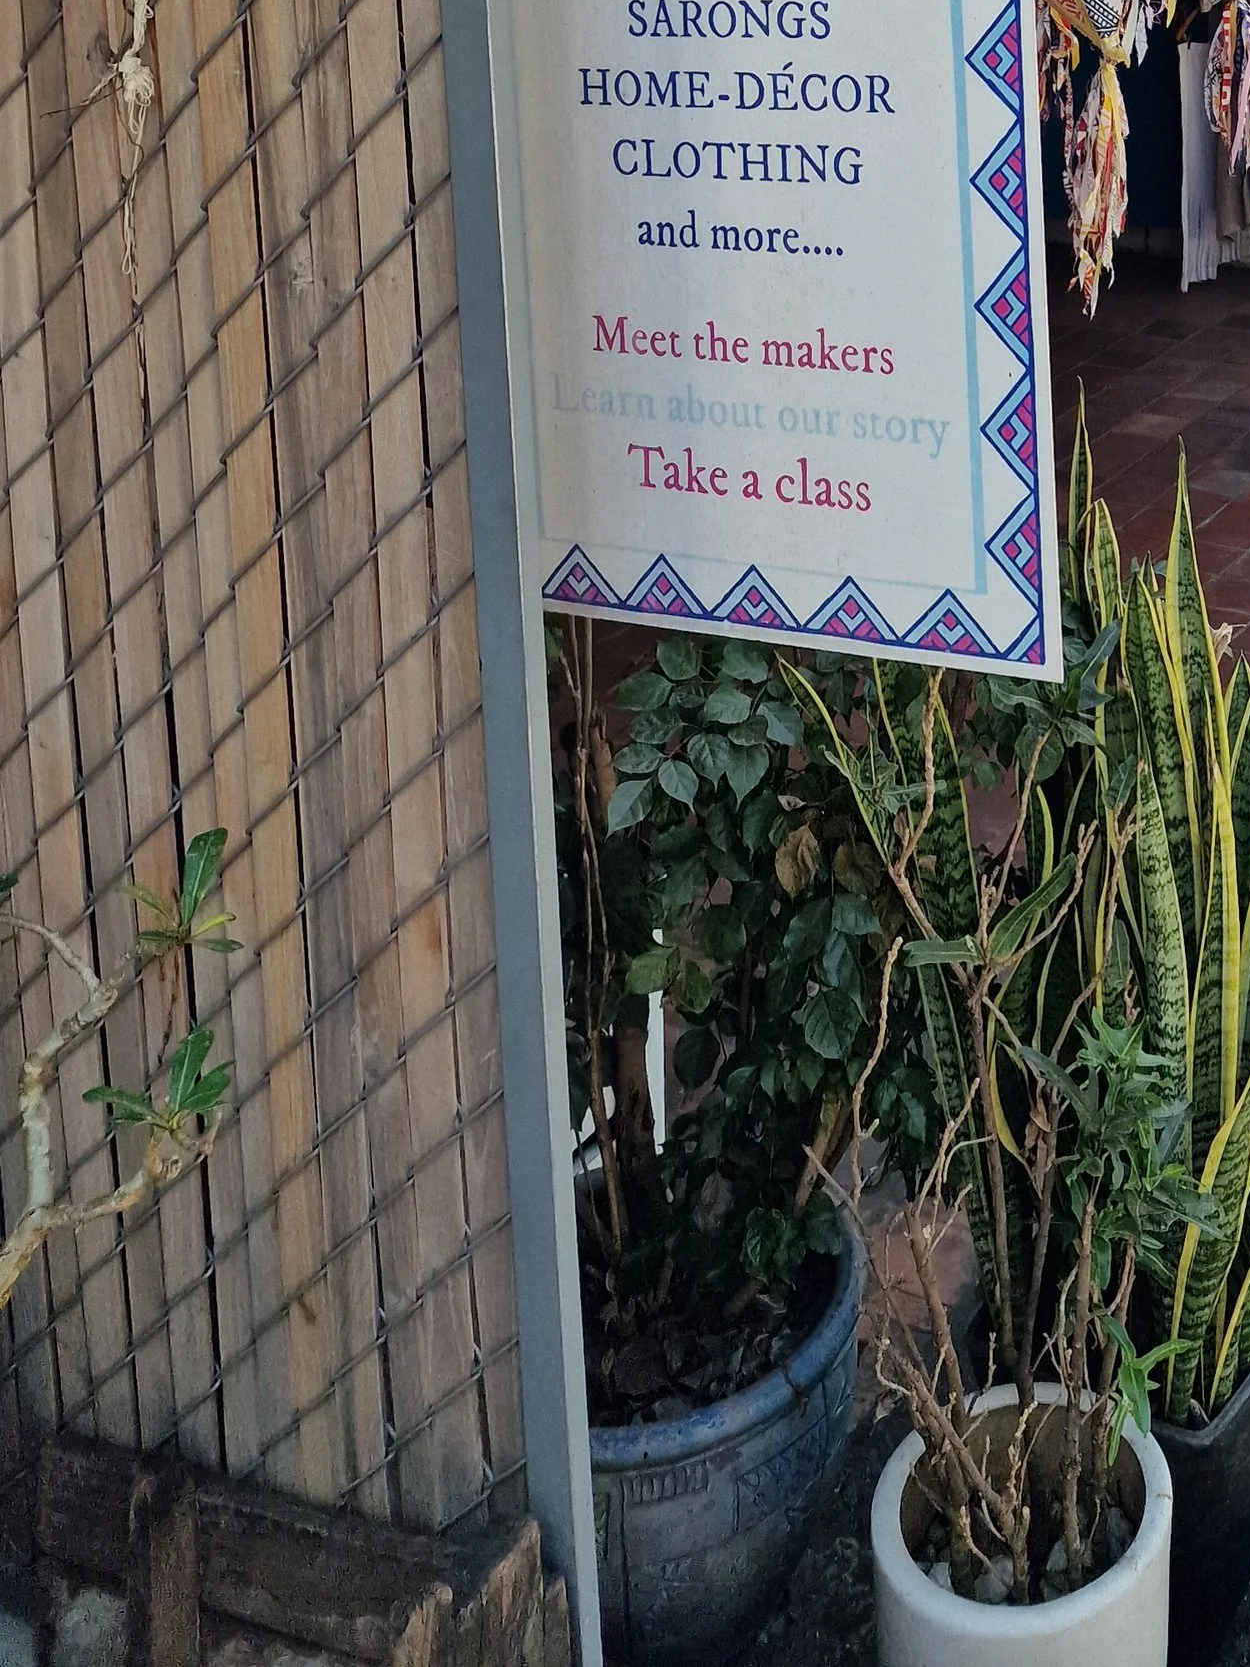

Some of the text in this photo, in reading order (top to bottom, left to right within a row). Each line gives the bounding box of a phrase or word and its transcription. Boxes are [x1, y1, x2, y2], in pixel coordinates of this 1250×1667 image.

[577, 61, 896, 115] HOME-DÉCOR
[611, 137, 864, 185] CLOTHING
[637, 209, 844, 257] and more....
[591, 313, 896, 377] Meet the makers
[552, 372, 951, 459] Learn about our story
[626, 442, 873, 514] Take a class
